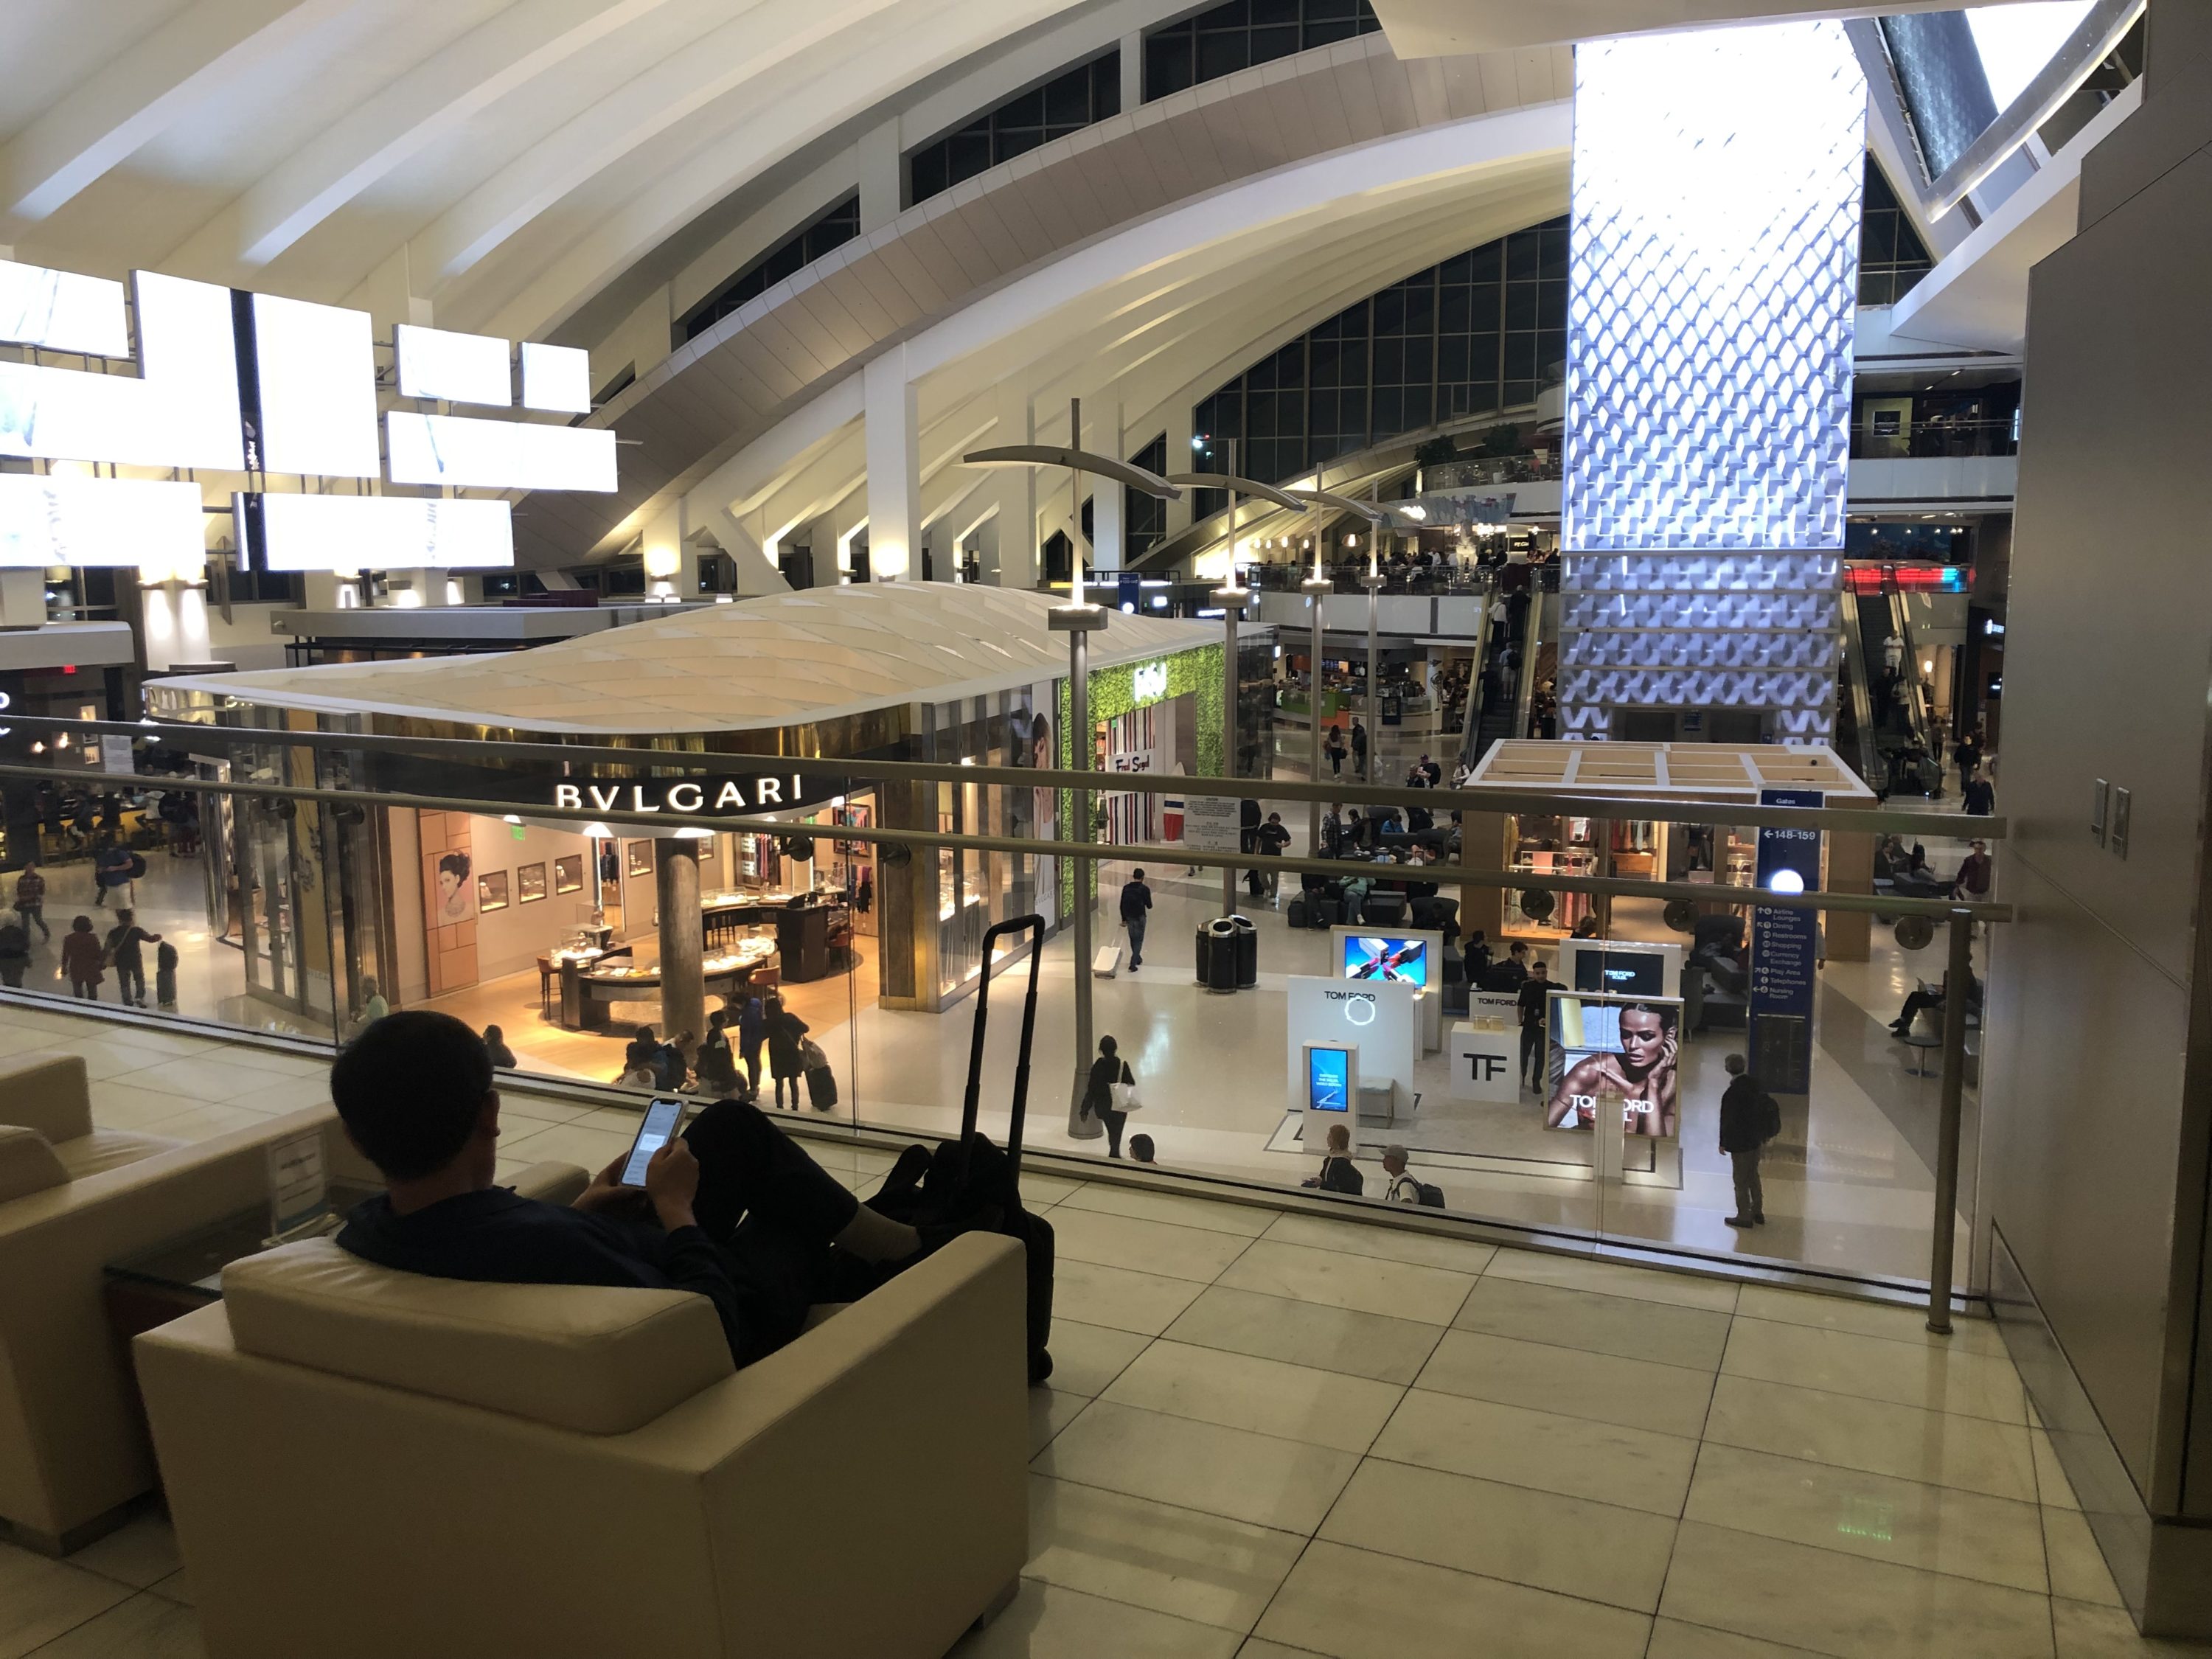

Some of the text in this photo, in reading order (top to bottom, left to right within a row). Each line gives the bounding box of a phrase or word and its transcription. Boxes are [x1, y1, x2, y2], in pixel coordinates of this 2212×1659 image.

[556, 774, 802, 812] BVLGARI
[1775, 830, 1816, 840] 148-159
[1773, 922, 1793, 931] Dining
[1771, 942, 1802, 950] Shopping
[1770, 978, 1806, 986] Telephones
[1324, 991, 1376, 1002] TOM FORD
[1463, 1053, 1507, 1082] TF
[1569, 1094, 1655, 1113] TO ORD
